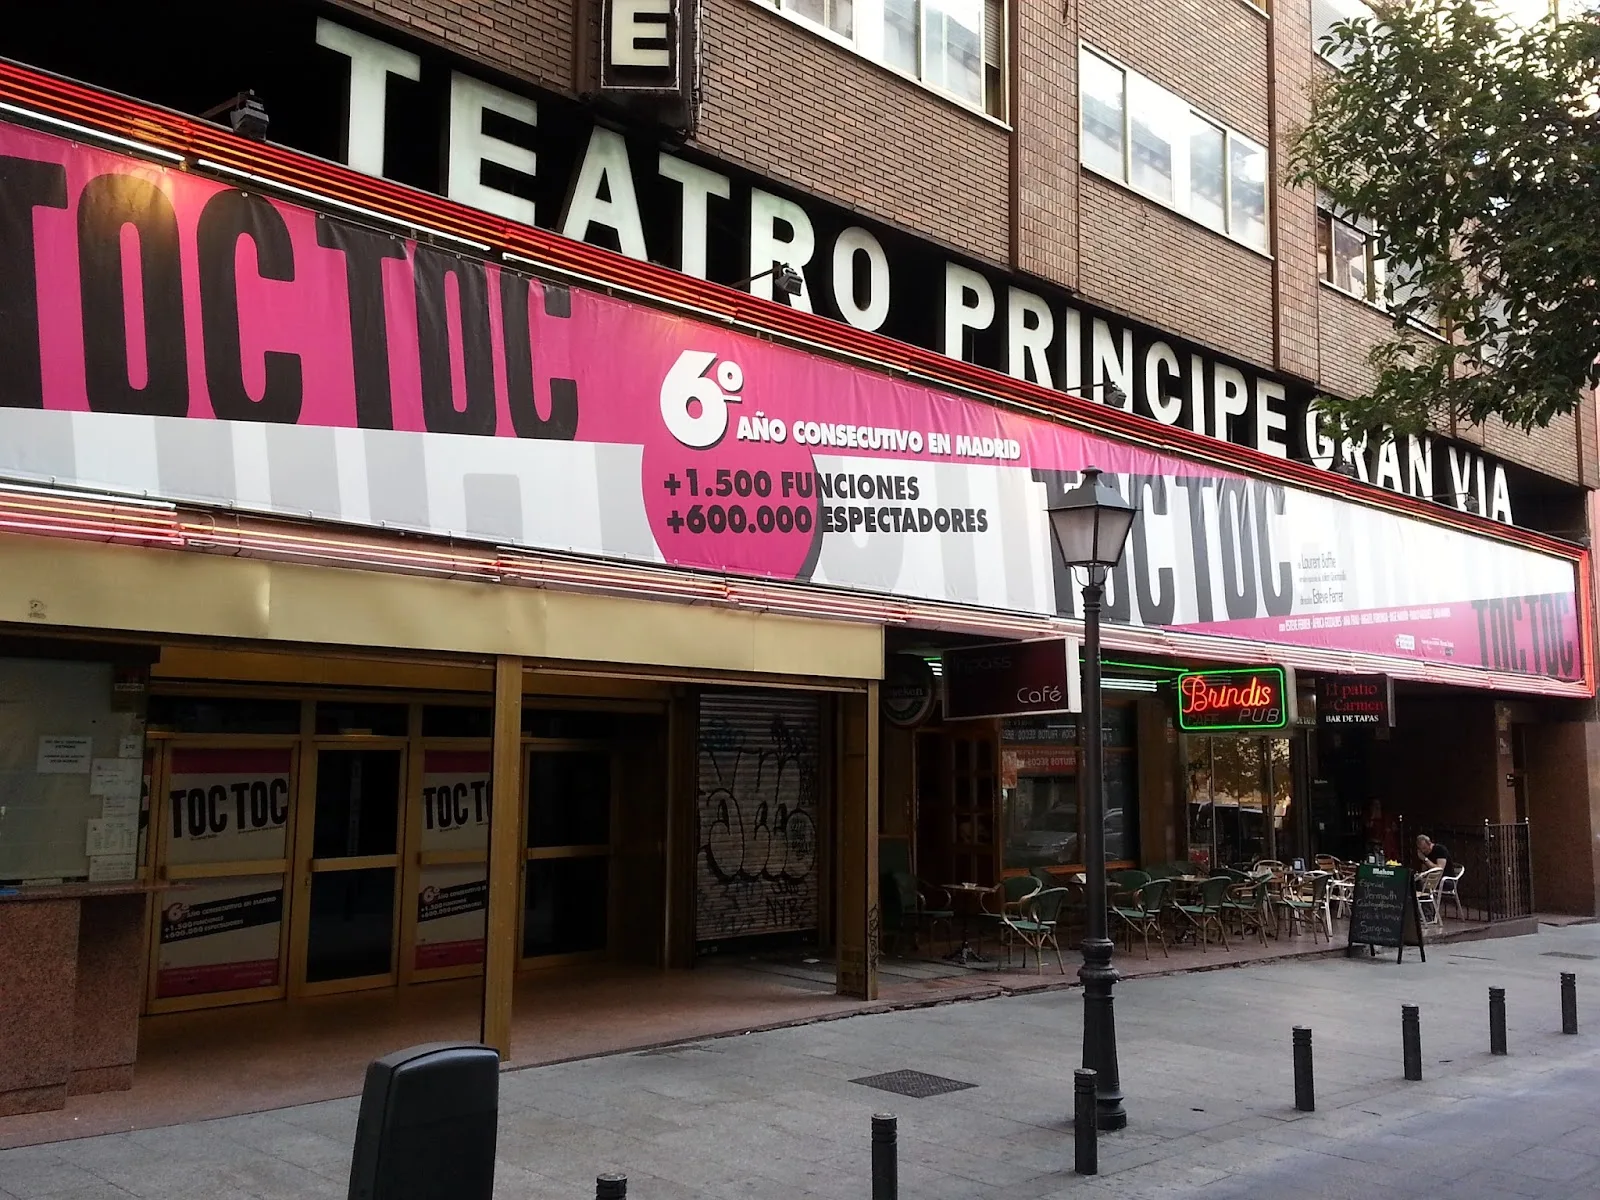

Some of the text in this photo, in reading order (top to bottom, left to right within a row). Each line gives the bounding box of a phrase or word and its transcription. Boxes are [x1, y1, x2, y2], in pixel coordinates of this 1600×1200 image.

[316, 16, 890, 333] TEATRO
[945, 260, 1287, 459] PRINCIPE
[1448, 446, 1513, 526] VIA
[0, 154, 579, 441] TOC TOC
[736, 411, 1021, 461] AÑO CONSECUTIVO EN MADRID
[664, 469, 920, 501] +1.500 FUNCIONES
[667, 504, 989, 534] +600.000 ESPECTADORES
[1176, 477, 1294, 623] TOC
[1017, 685, 1063, 704] Café
[1182, 676, 1272, 714] Brindis
[1333, 699, 1385, 712] Carmen
[1341, 682, 1378, 700] patio
[1238, 708, 1280, 724] PUB
[1325, 714, 1342, 723] BAR
[1342, 714, 1354, 723] DE
[1354, 714, 1380, 723] TAPAS
[169, 785, 228, 838] TOC
[231, 778, 288, 830] TOC
[423, 782, 469, 830] TOC
